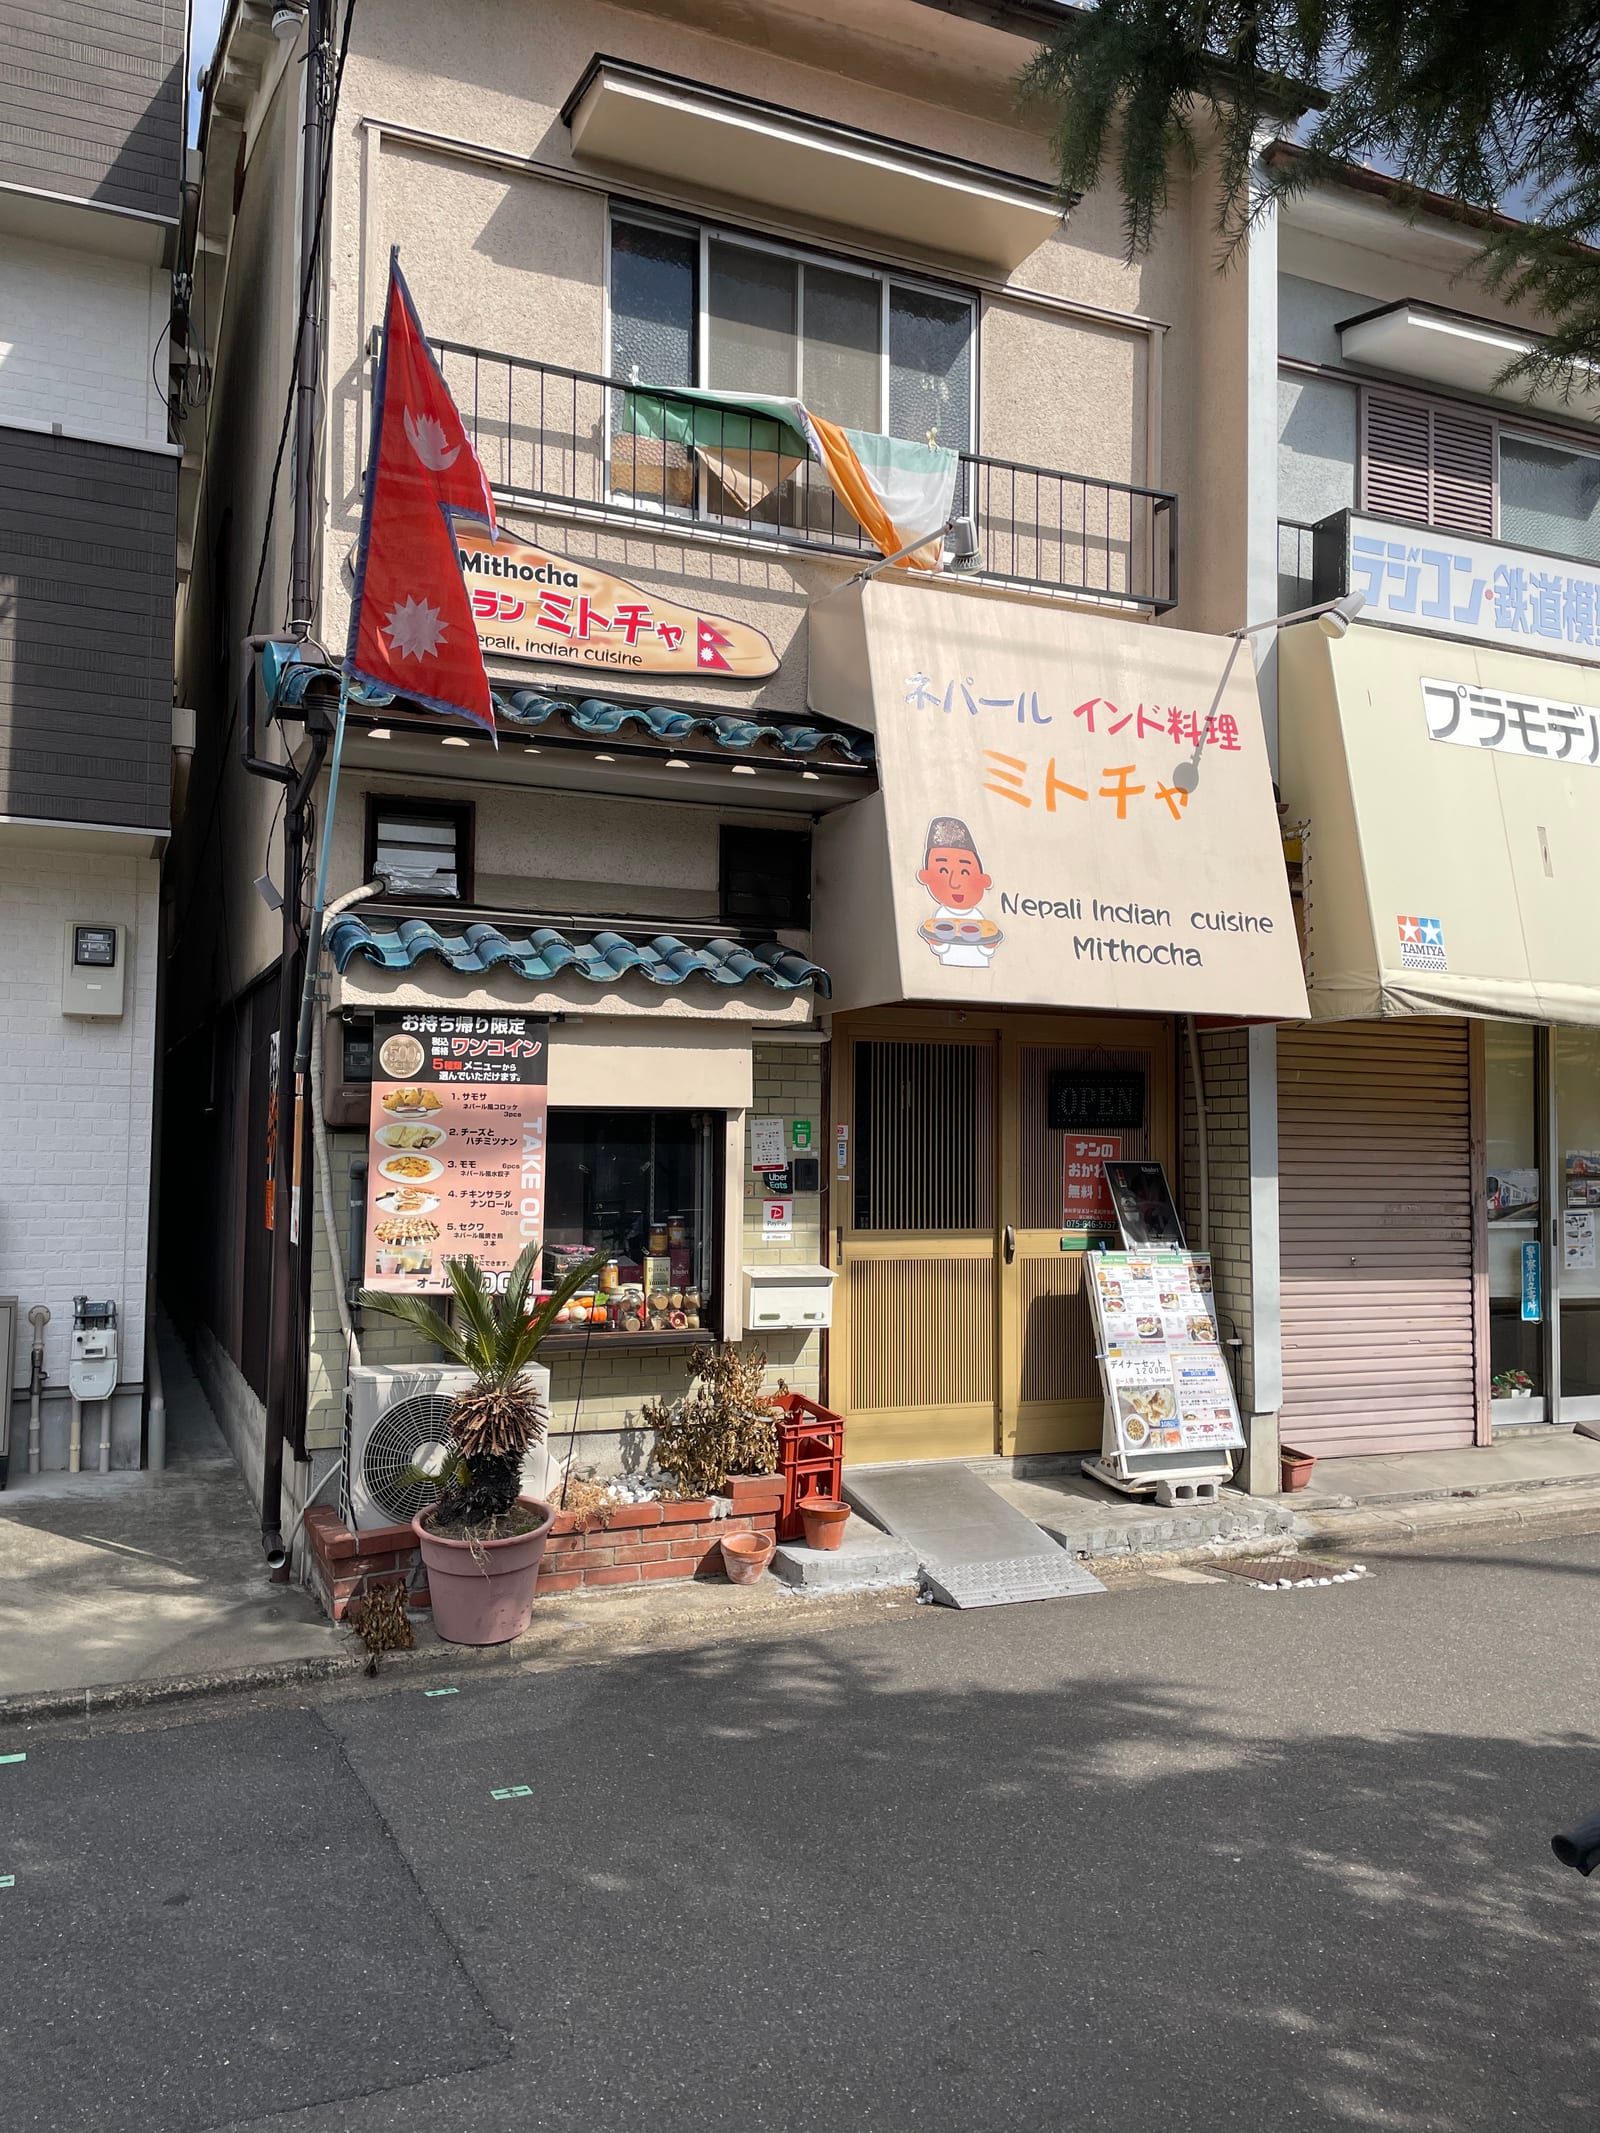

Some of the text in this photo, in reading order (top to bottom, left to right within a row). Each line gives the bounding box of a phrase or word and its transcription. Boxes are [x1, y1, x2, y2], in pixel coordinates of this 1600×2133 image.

[460, 550, 579, 588] Mithocha
[1352, 536, 1600, 646] ラジコン・鉄道模
[472, 588, 684, 650] ラン ミトチャ
[477, 634, 643, 667] epali, indian cuisine
[904, 671, 1242, 752] ネパール インド料理
[981, 748, 1190, 821] ミトチャ
[1000, 891, 1275, 935] Nepali Indian cuisine
[1073, 935, 1204, 968] Mithocha
[1401, 942, 1446, 957] TAMIYA
[401, 1014, 526, 1036] お持ち帰り限定
[451, 1037, 543, 1059] ワンコイン
[462, 1092, 488, 1101] サモサ
[1059, 1087, 1135, 1116] OPEN
[449, 1128, 495, 1137] 2. チーズと
[466, 1137, 518, 1146] ハチミツナン
[1075, 1141, 1114, 1158] ナンの
[521, 1116, 543, 1190] TAKE
[447, 1160, 457, 1169] 3.
[459, 1160, 477, 1169] モモ
[1068, 1162, 1106, 1179] おかわ
[768, 1173, 788, 1181] Uber
[769, 1181, 788, 1189] Eats
[447, 1190, 512, 1199] 4. チキンサラダ
[470, 1199, 513, 1209] ナンロール
[446, 1222, 485, 1231] 5. セクワ
[767, 1220, 788, 1228] PayPay
[416, 1277, 453, 1289] オール
